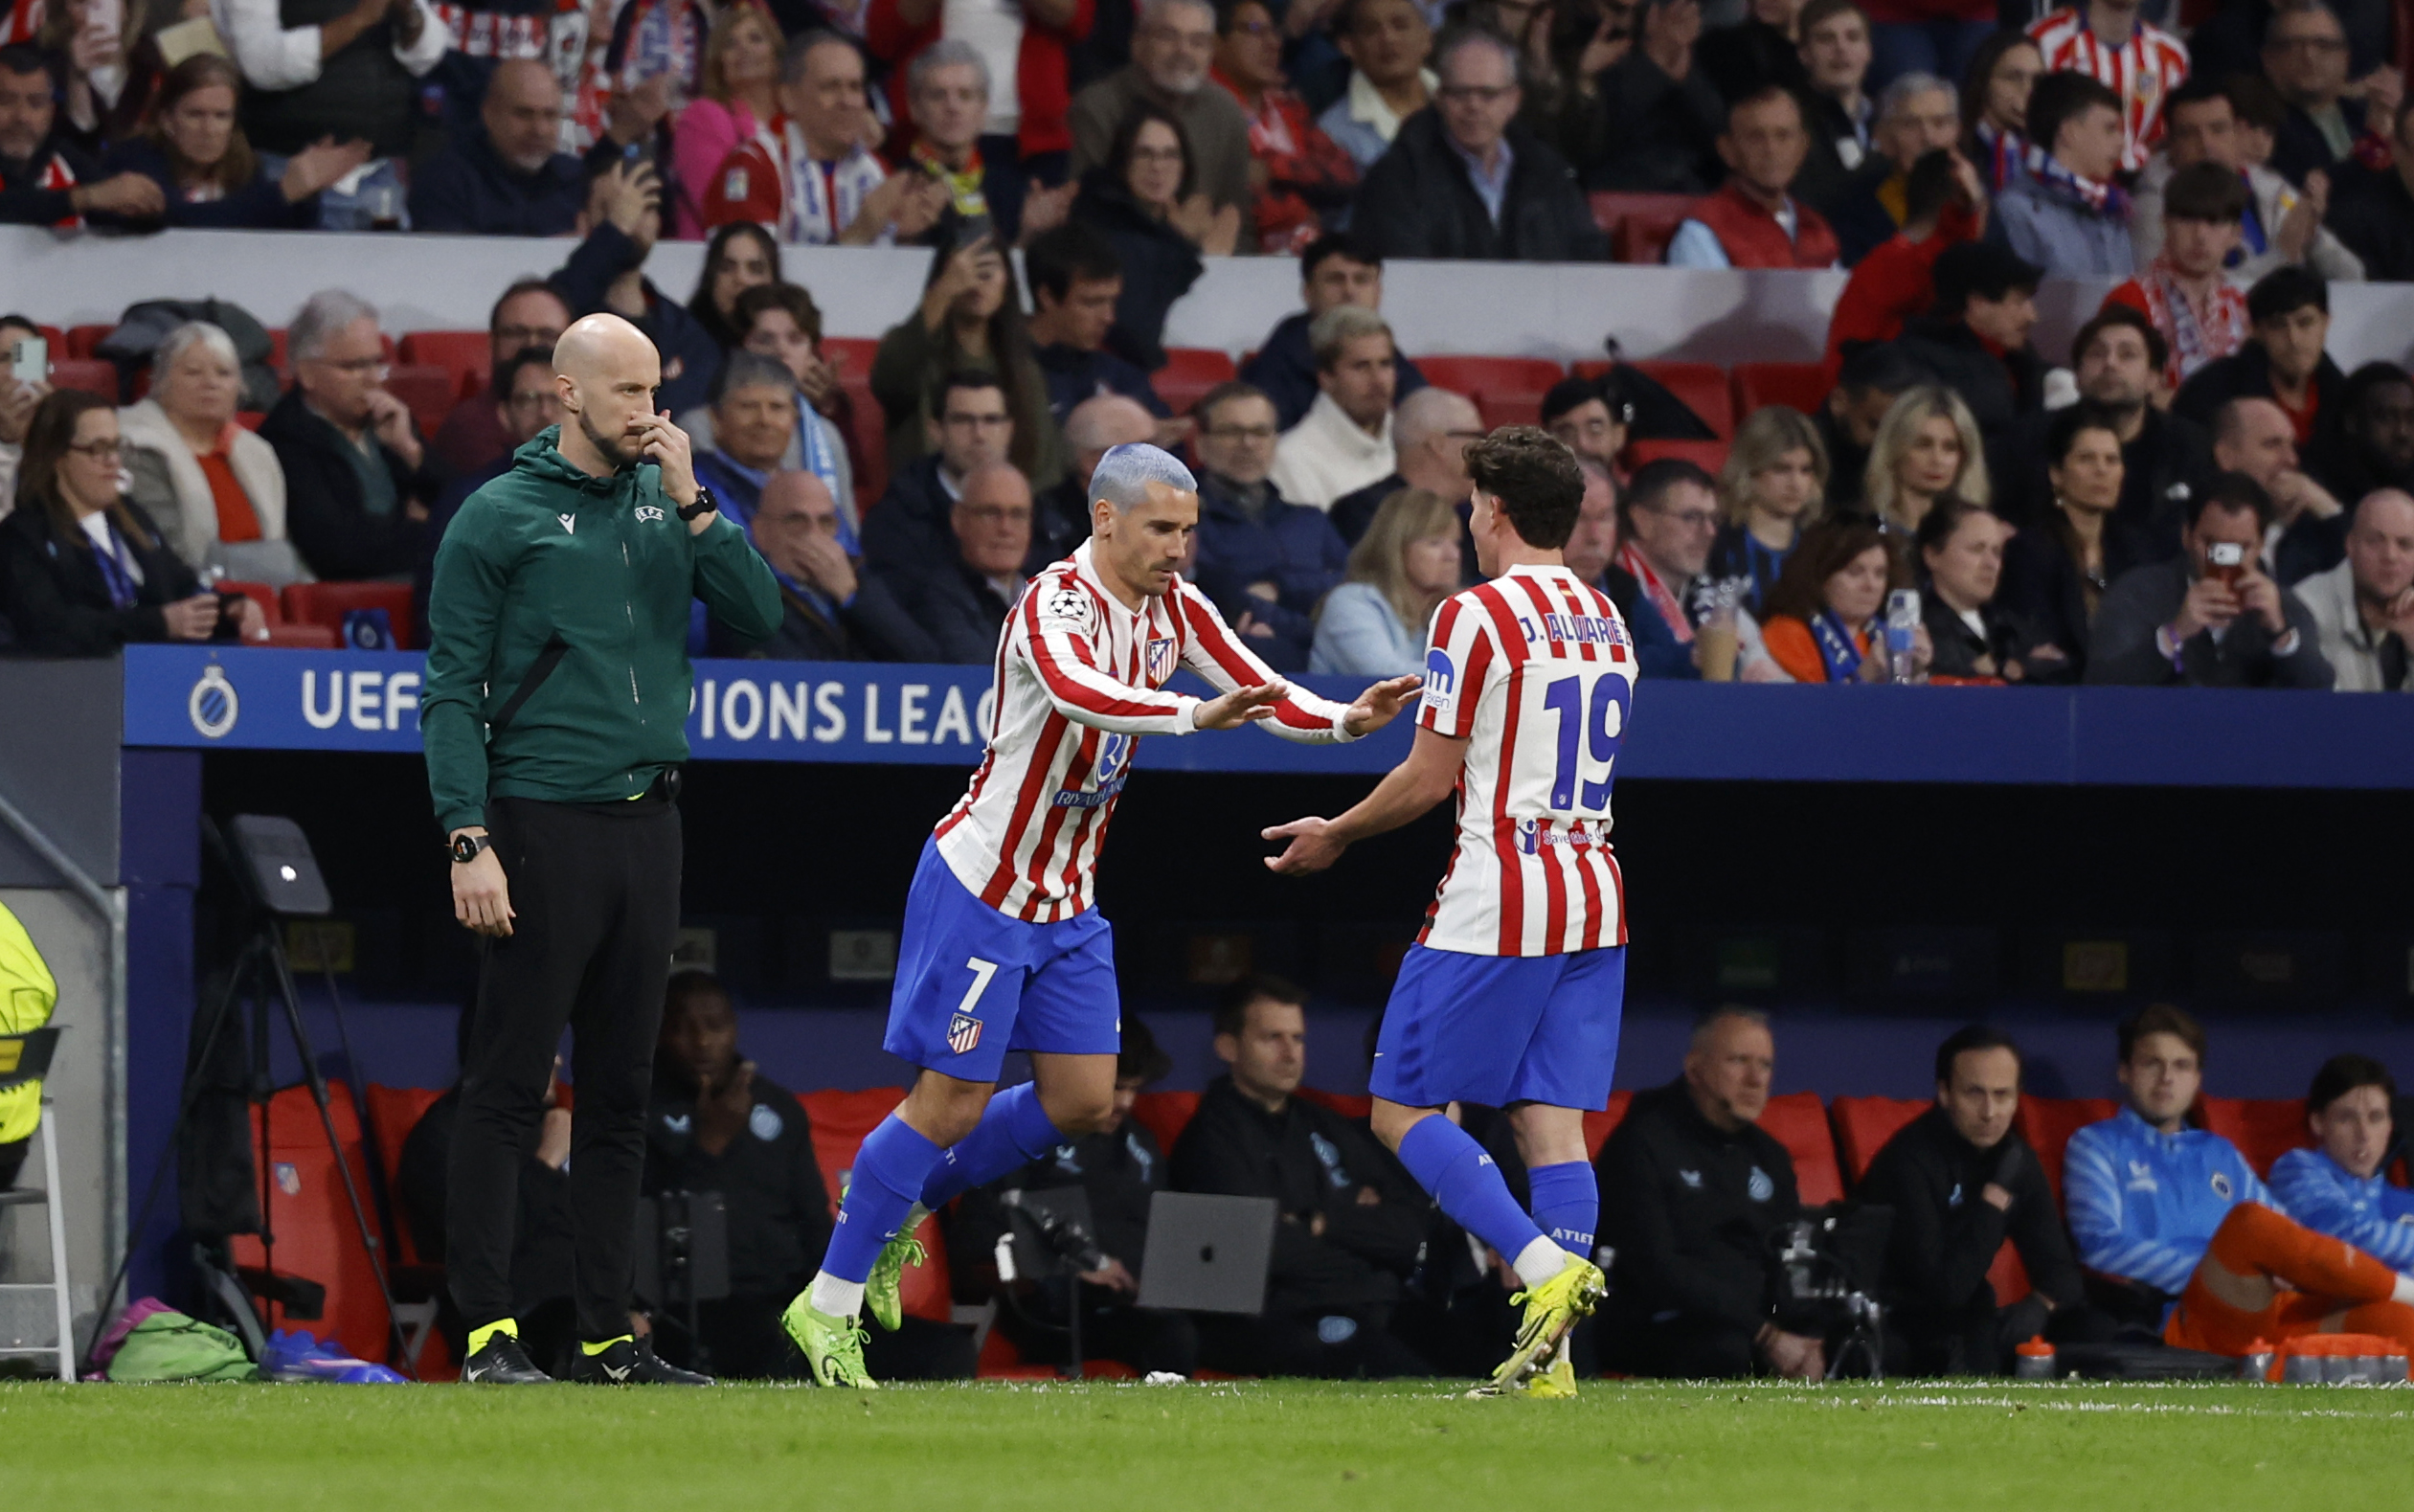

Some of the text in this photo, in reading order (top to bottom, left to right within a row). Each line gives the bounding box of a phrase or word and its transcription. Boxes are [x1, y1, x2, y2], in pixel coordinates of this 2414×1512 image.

[1519, 616, 1545, 643] J.
[301, 669, 421, 731] UEF
[1544, 672, 1631, 811] 19
[1543, 830, 1569, 845] Save
[959, 956, 999, 1013] 7
[1549, 1227, 1595, 1247] ATLET
